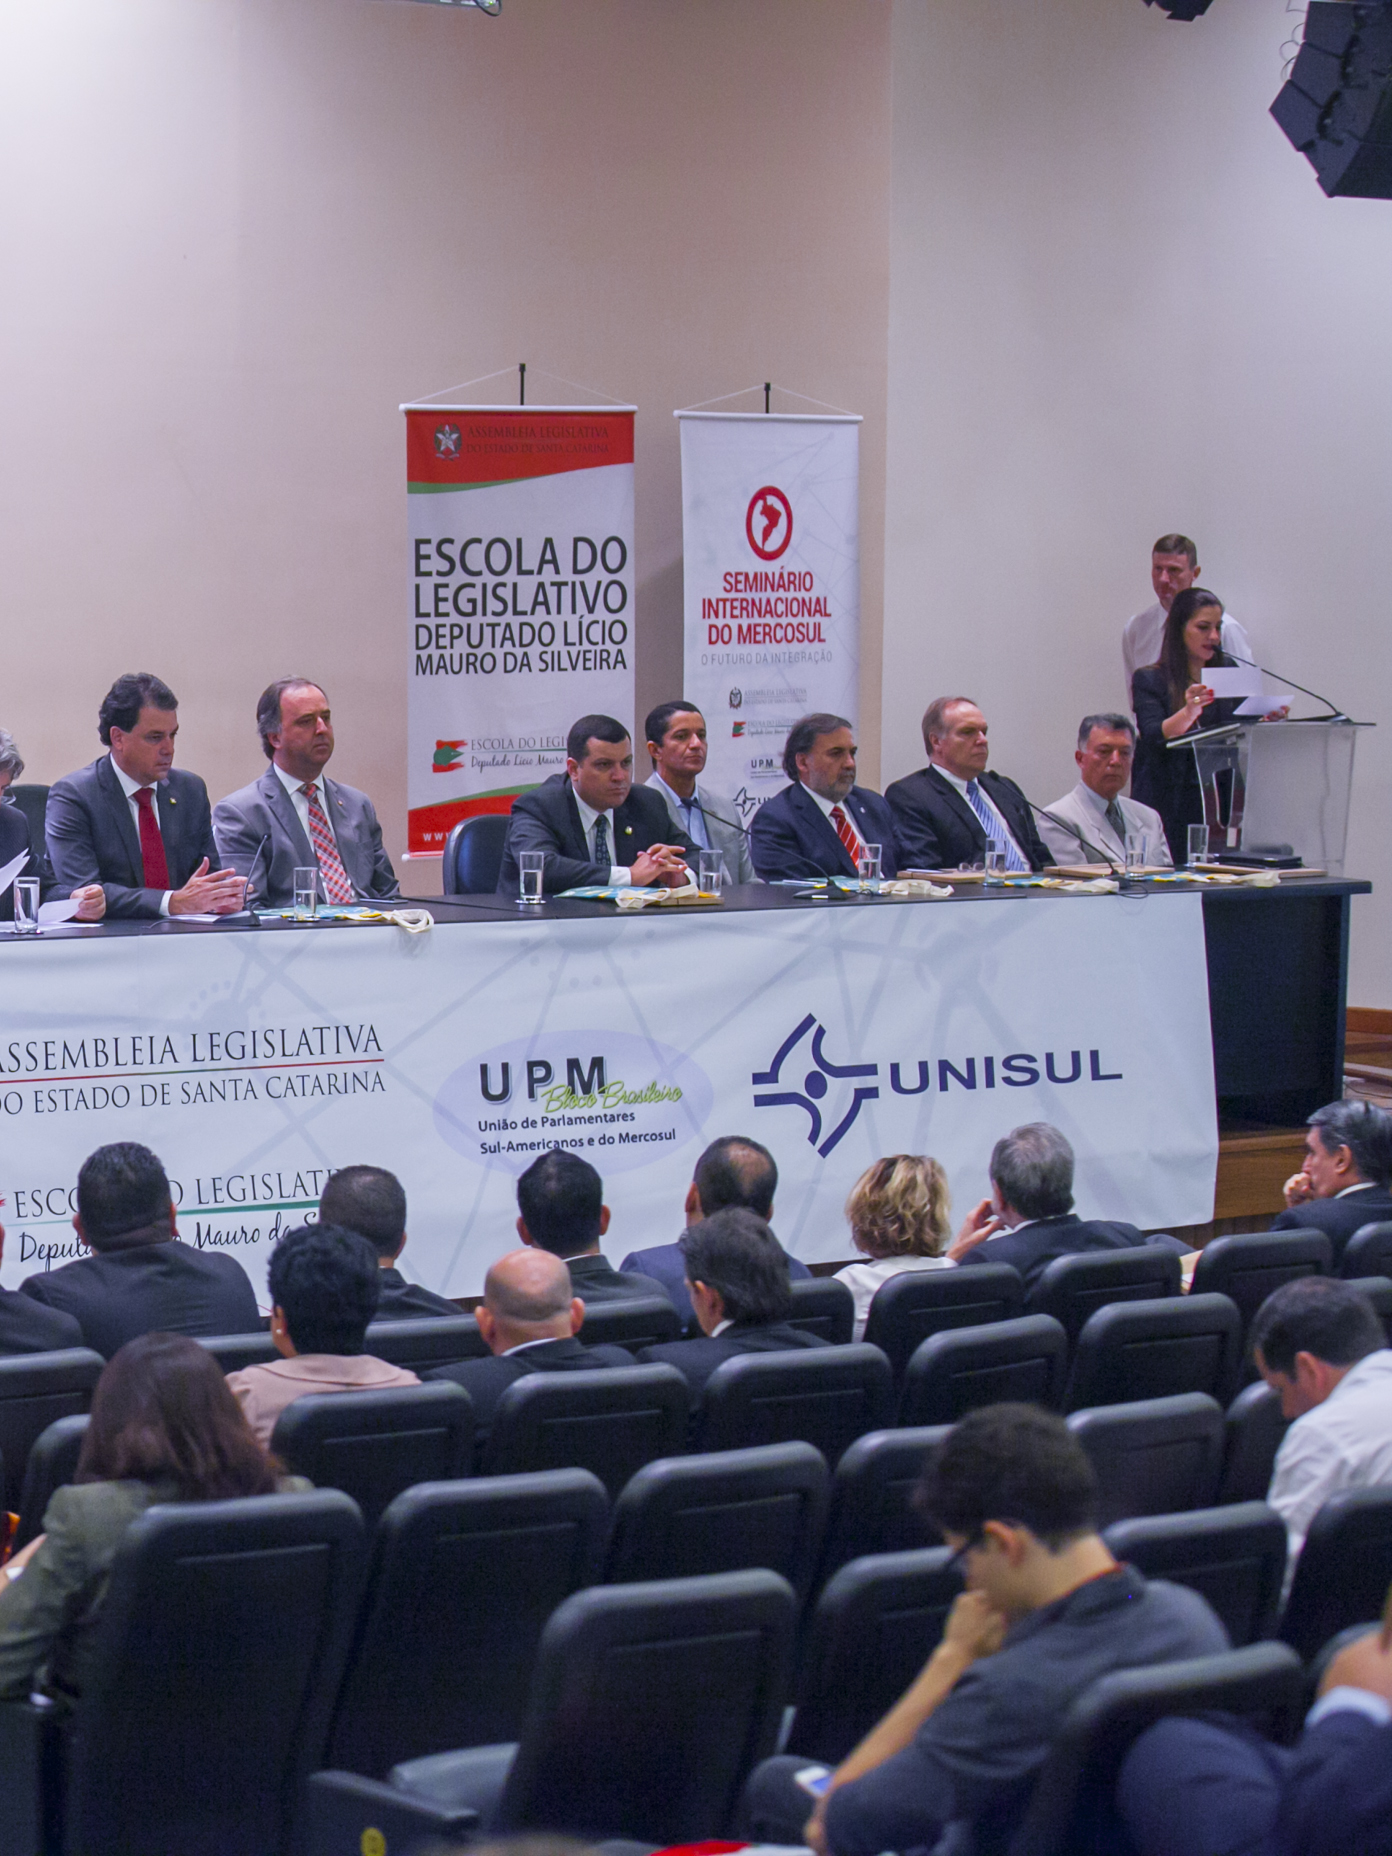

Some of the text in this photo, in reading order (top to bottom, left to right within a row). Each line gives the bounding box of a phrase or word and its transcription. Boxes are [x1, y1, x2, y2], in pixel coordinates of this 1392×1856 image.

[467, 425, 610, 439] ASSEMBLEIA LEGISLATIVA
[414, 535, 628, 578] ESCOLA DO
[723, 565, 814, 593] SEMINÁRIO
[414, 579, 628, 619] LEGISLATIVO
[702, 596, 832, 619] INTERNACIONAL
[414, 614, 628, 651] DEPUTADO LÍCIO
[708, 622, 826, 645] DO MERCOSUL
[415, 648, 627, 676] MAURO DA SILVEIRA
[701, 648, 833, 666] O FUTURO DA INTEGRAÇÃO
[471, 738, 514, 751] ESCOLA
[518, 737, 536, 749] DO
[471, 753, 564, 773] Deputado Lício Mauro
[751, 759, 773, 769] UPM
[190, 1024, 383, 1063] LEGISLATIVA
[480, 1056, 607, 1104] UPM
[890, 1049, 1123, 1095] UNISUL
[34, 1084, 131, 1114] ESTADO
[140, 1083, 171, 1107] DE
[180, 1078, 258, 1105] SANTA
[265, 1071, 386, 1099] CATARINA
[540, 1080, 683, 1113] Bloco Brasileiro
[478, 1111, 636, 1132] União de Parlamentares
[480, 1128, 676, 1154] Sul-Americanos e do Mercosul
[192, 1221, 260, 1249] Mauro
